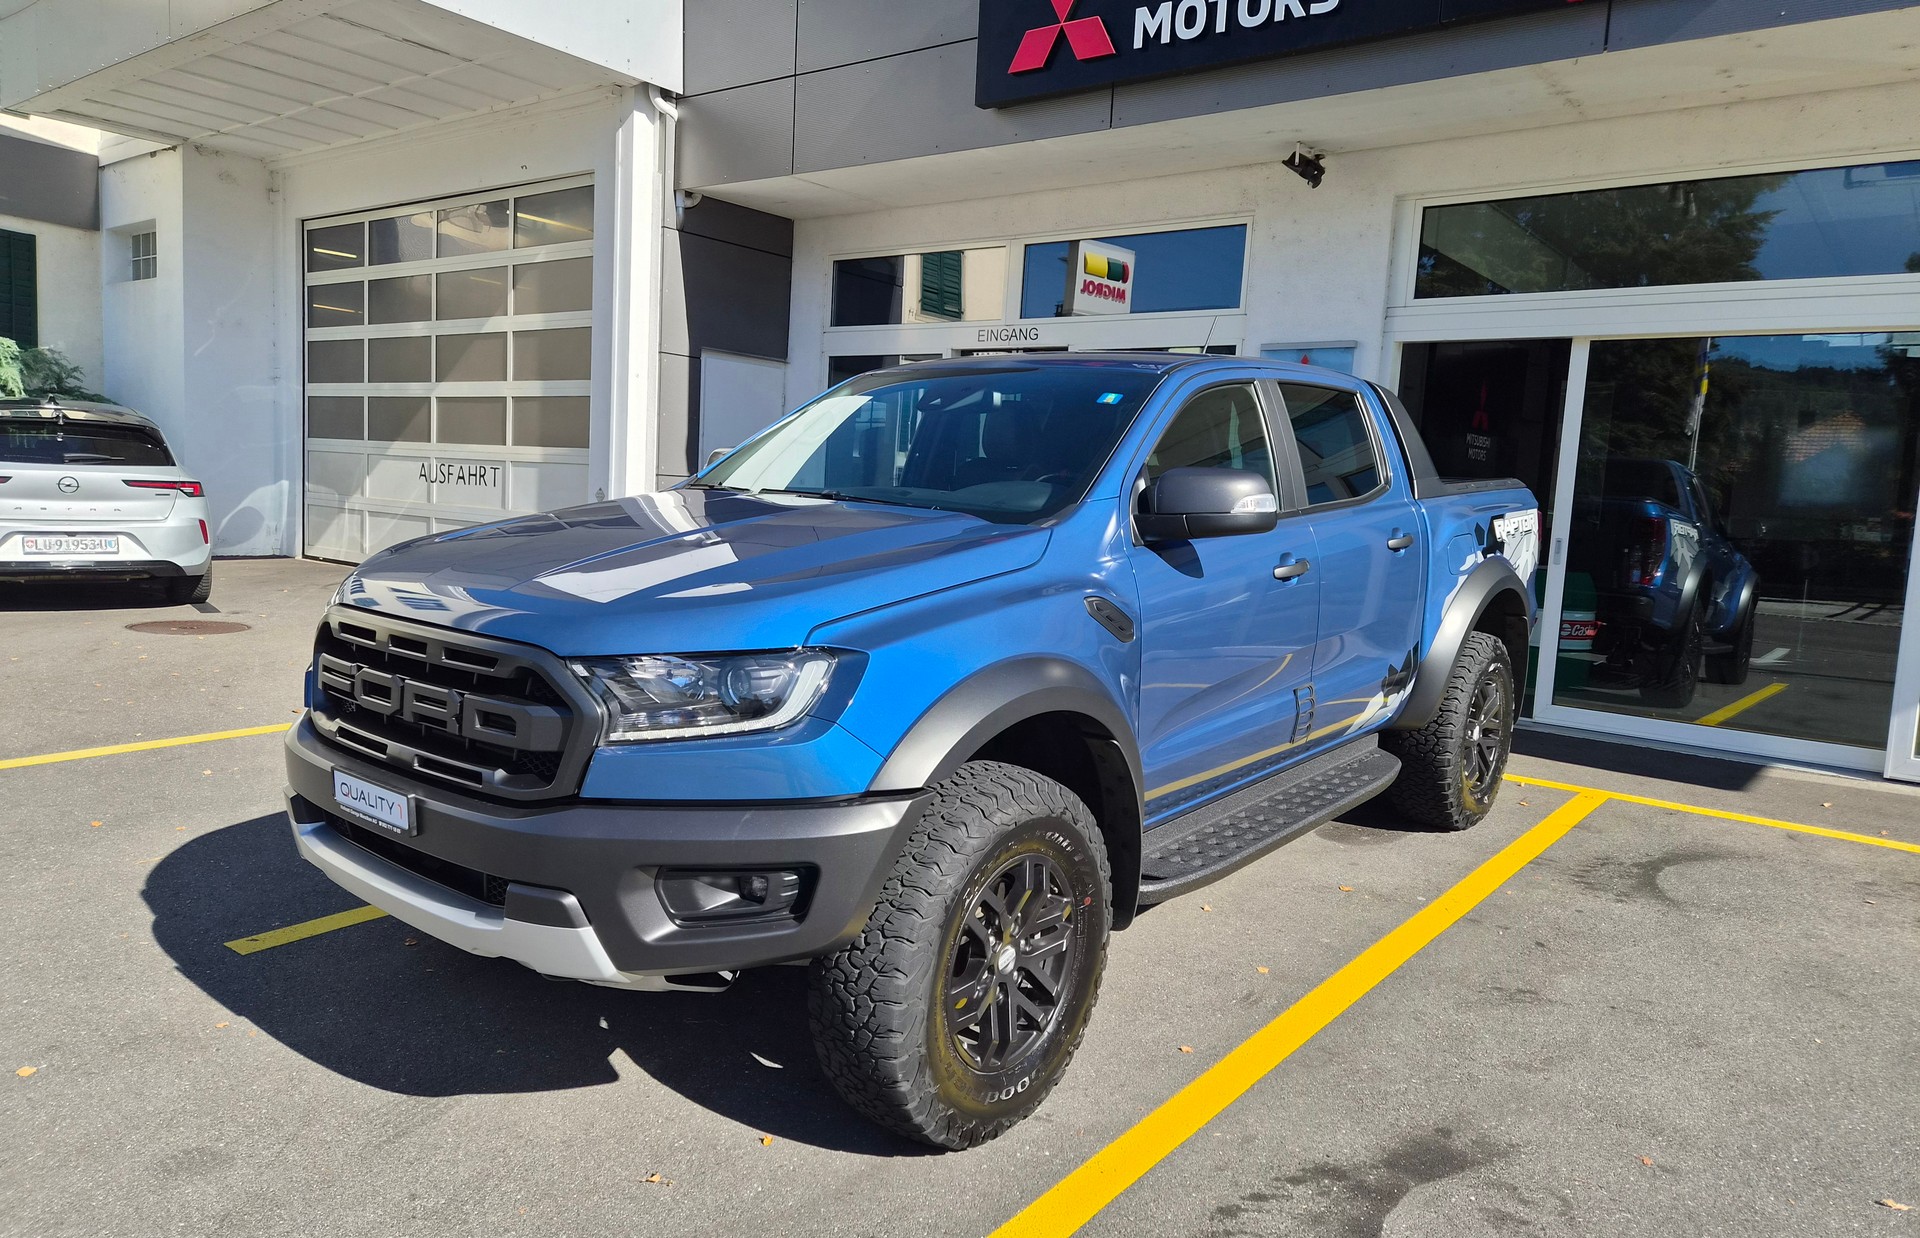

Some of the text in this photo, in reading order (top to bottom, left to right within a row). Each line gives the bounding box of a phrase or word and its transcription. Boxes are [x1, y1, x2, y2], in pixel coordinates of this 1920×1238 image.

[977, 327, 1039, 342] EINGANG
[419, 462, 500, 487] AUSFAHRT
[1493, 513, 1536, 541] RAPTOR
[318, 653, 550, 751] FORD
[340, 781, 395, 816] QUALITY
